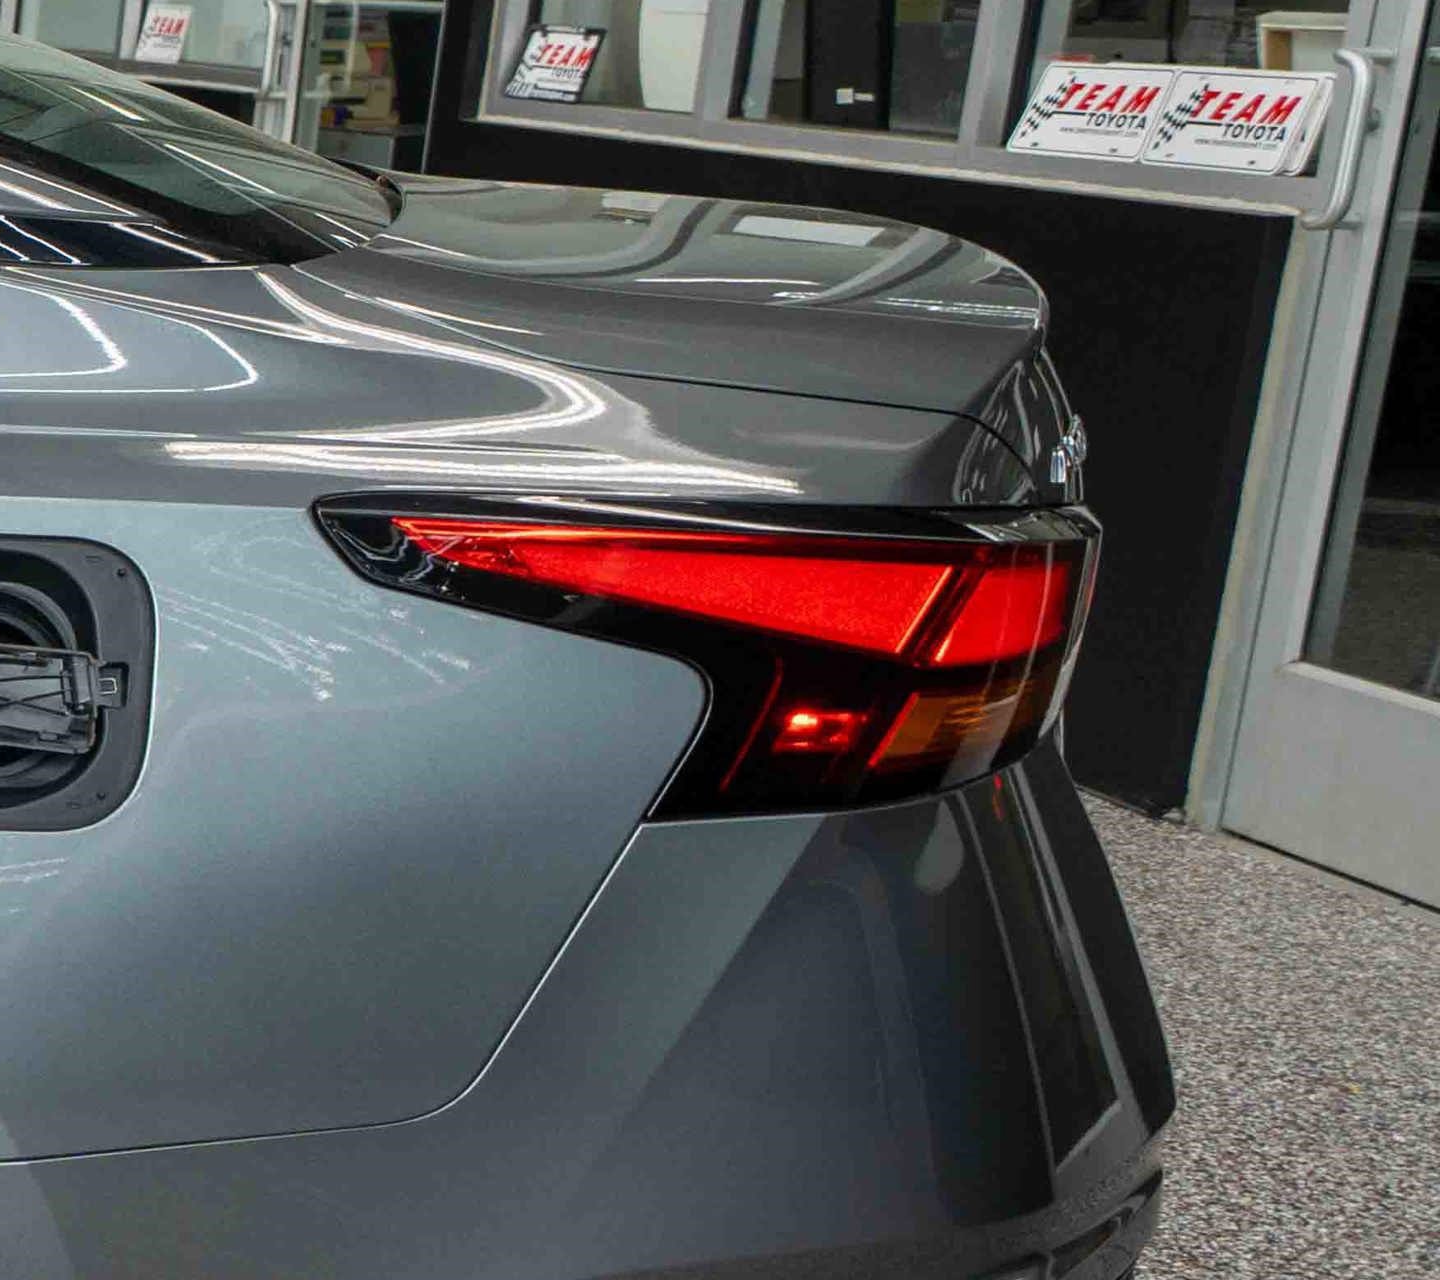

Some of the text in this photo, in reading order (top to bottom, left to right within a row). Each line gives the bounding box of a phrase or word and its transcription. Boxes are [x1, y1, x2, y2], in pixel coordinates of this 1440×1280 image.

[536, 44, 597, 67] TEAM
[1057, 82, 1161, 114] TEAM
[1190, 89, 1302, 125] TEAM
[1085, 112, 1148, 130] TOYOTA
[1221, 123, 1286, 142] TOYOTA
